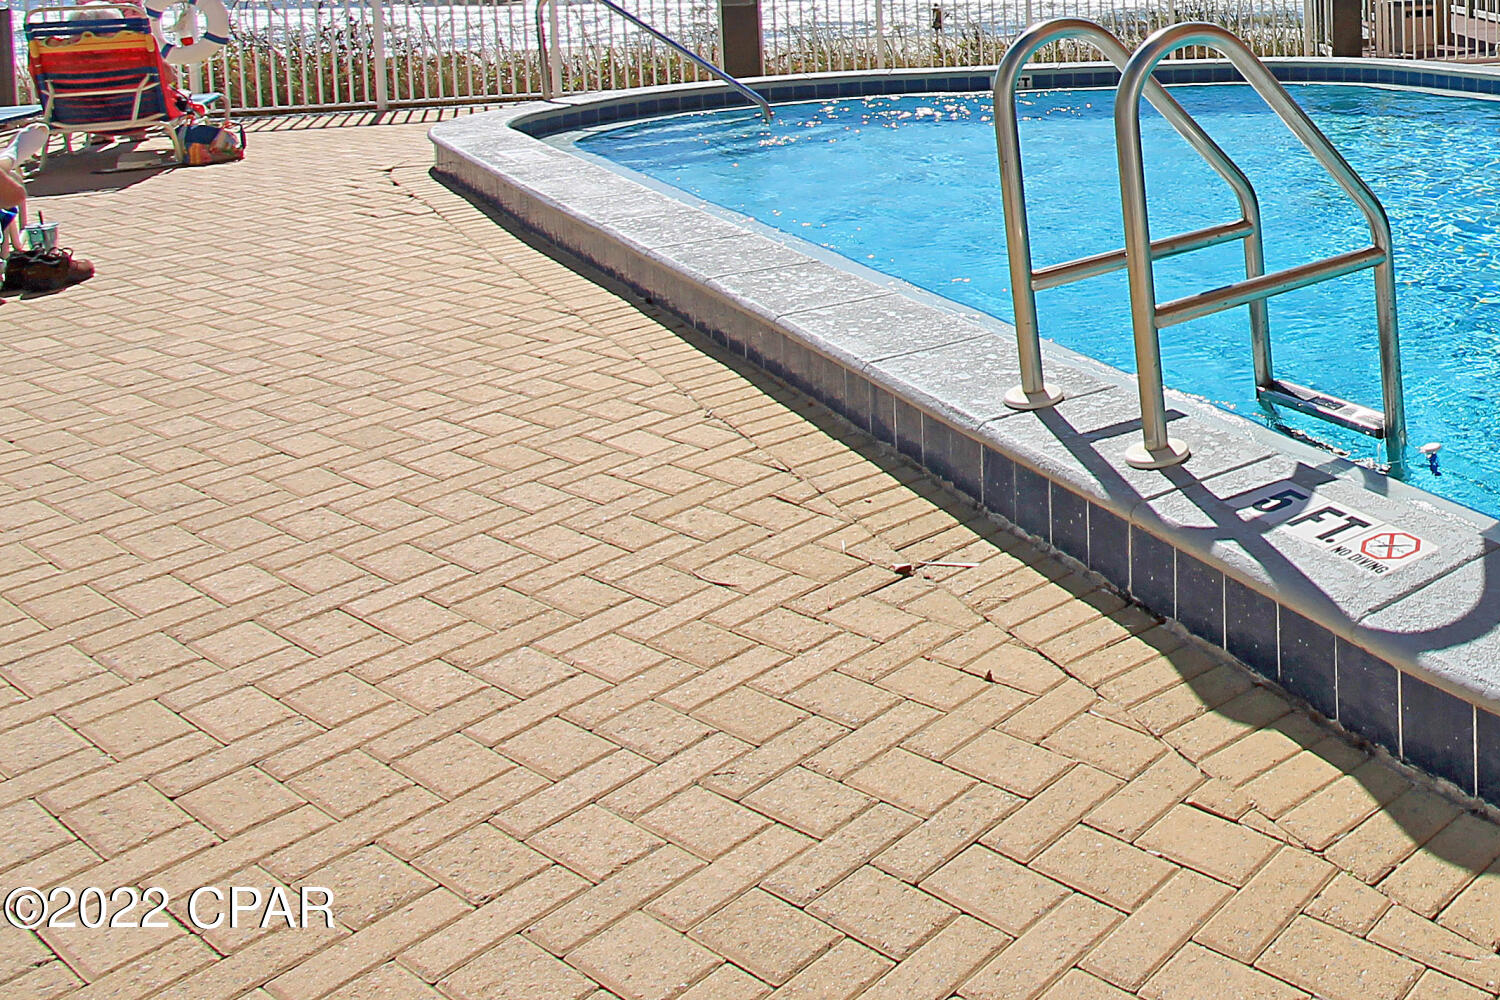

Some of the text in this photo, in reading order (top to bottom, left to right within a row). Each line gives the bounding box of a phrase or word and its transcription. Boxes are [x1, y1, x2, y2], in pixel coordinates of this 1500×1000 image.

[1252, 488, 1309, 512] 5
[1330, 545, 1389, 575] NO DIVING
